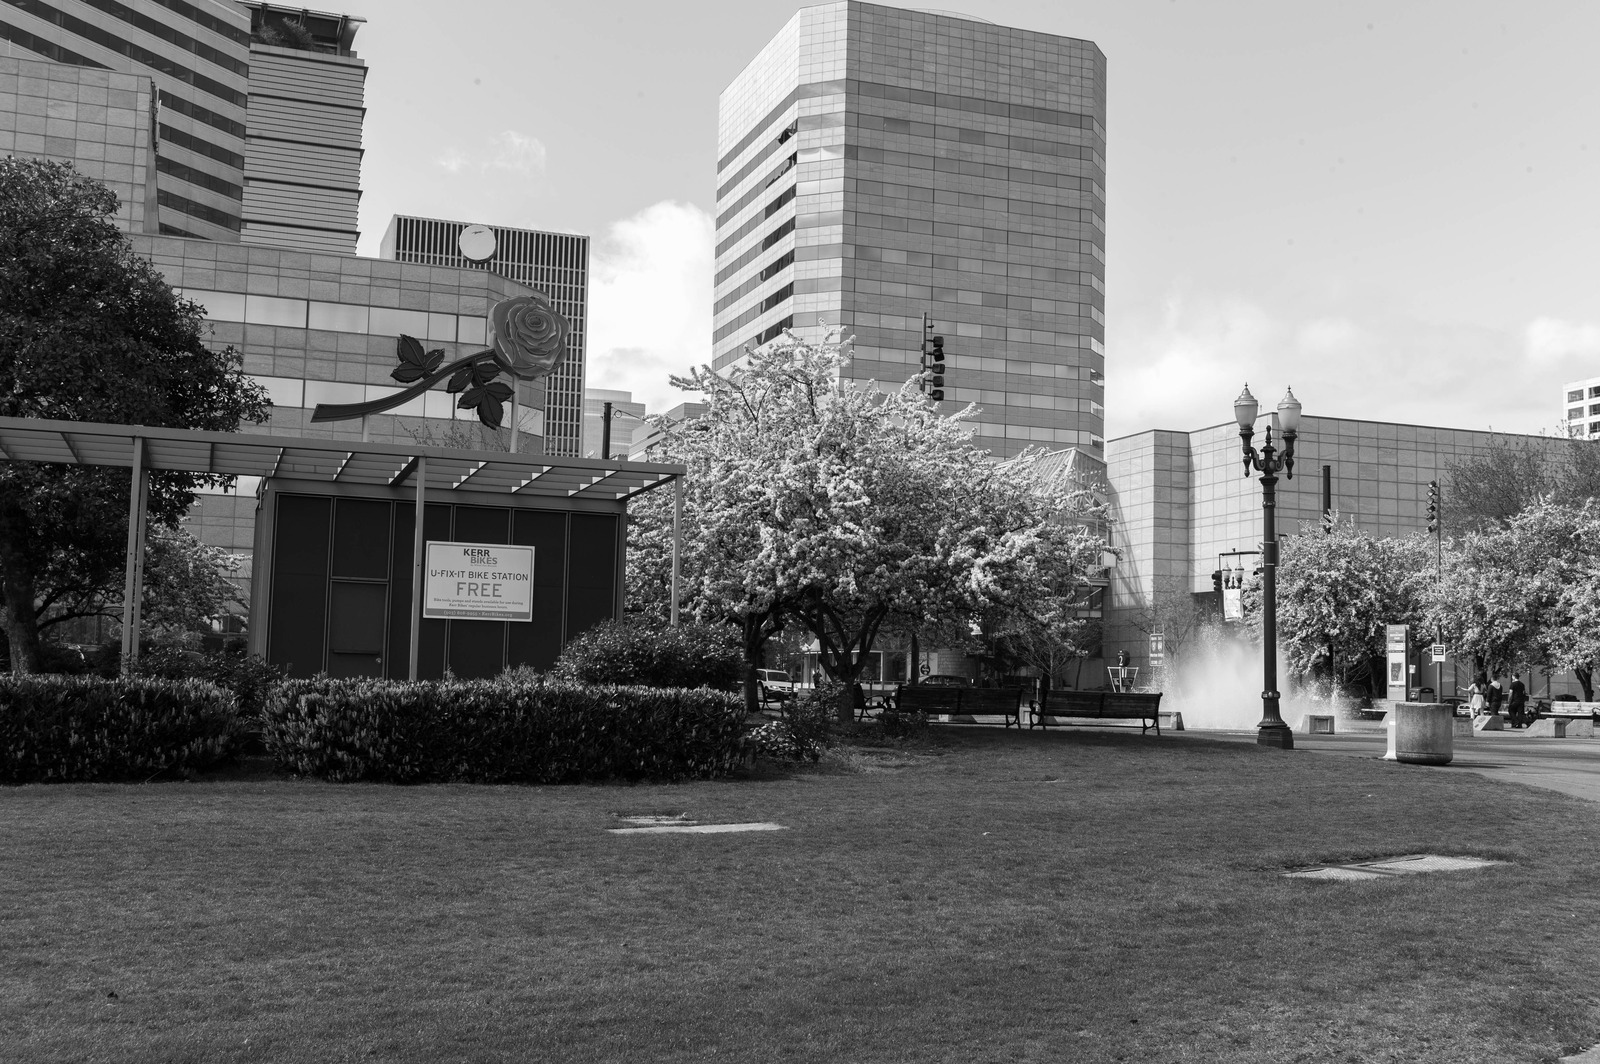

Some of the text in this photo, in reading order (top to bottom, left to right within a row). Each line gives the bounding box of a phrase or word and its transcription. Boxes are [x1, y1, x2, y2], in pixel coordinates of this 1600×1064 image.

[464, 548, 490, 556] KERR
[430, 570, 528, 581] U-FIX-IT BIKE STATION
[456, 582, 502, 598] FREE
